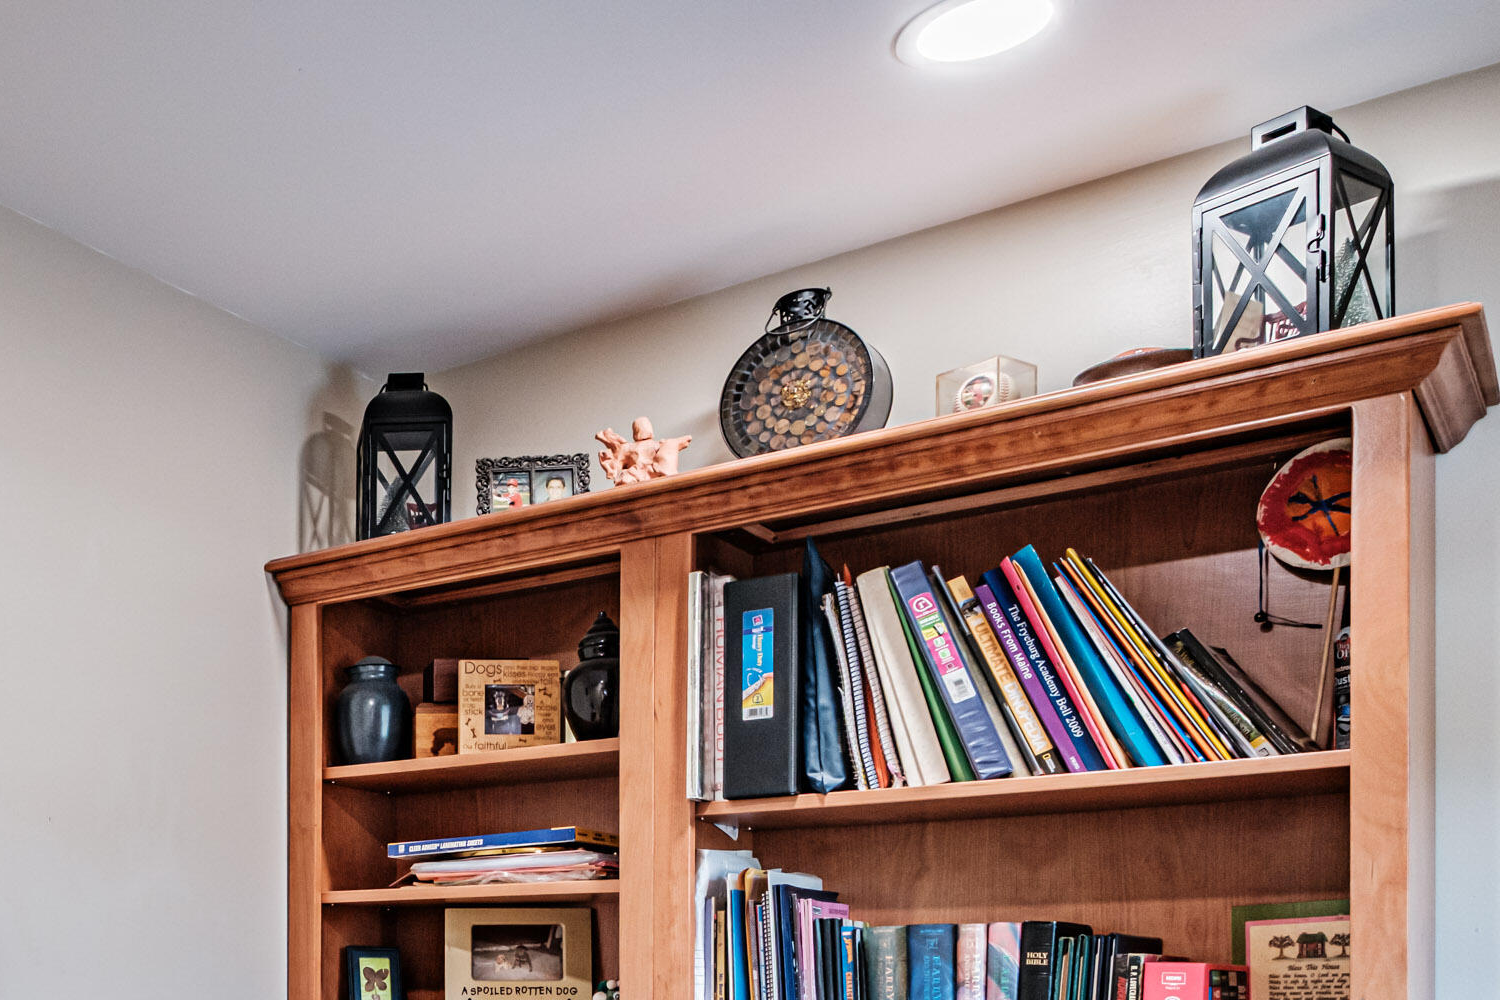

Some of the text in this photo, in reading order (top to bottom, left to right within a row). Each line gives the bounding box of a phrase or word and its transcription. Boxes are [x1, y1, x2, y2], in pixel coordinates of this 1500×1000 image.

[987, 602, 1033, 680] Books From Maine
[465, 662, 502, 677] Dogs
[1008, 604, 1020, 622] The
[1016, 621, 1040, 659] Fryeburg
[1036, 657, 1060, 697] Academy
[1055, 695, 1072, 716] Bell
[1066, 716, 1084, 738] 2009
[975, 622, 1048, 751] ULTIMATE DINOPEDIA
[474, 741, 507, 750] faithful
[1026, 951, 1049, 959] HOLY
[461, 986, 578, 995] A SPOILED ROTTEN DOG
